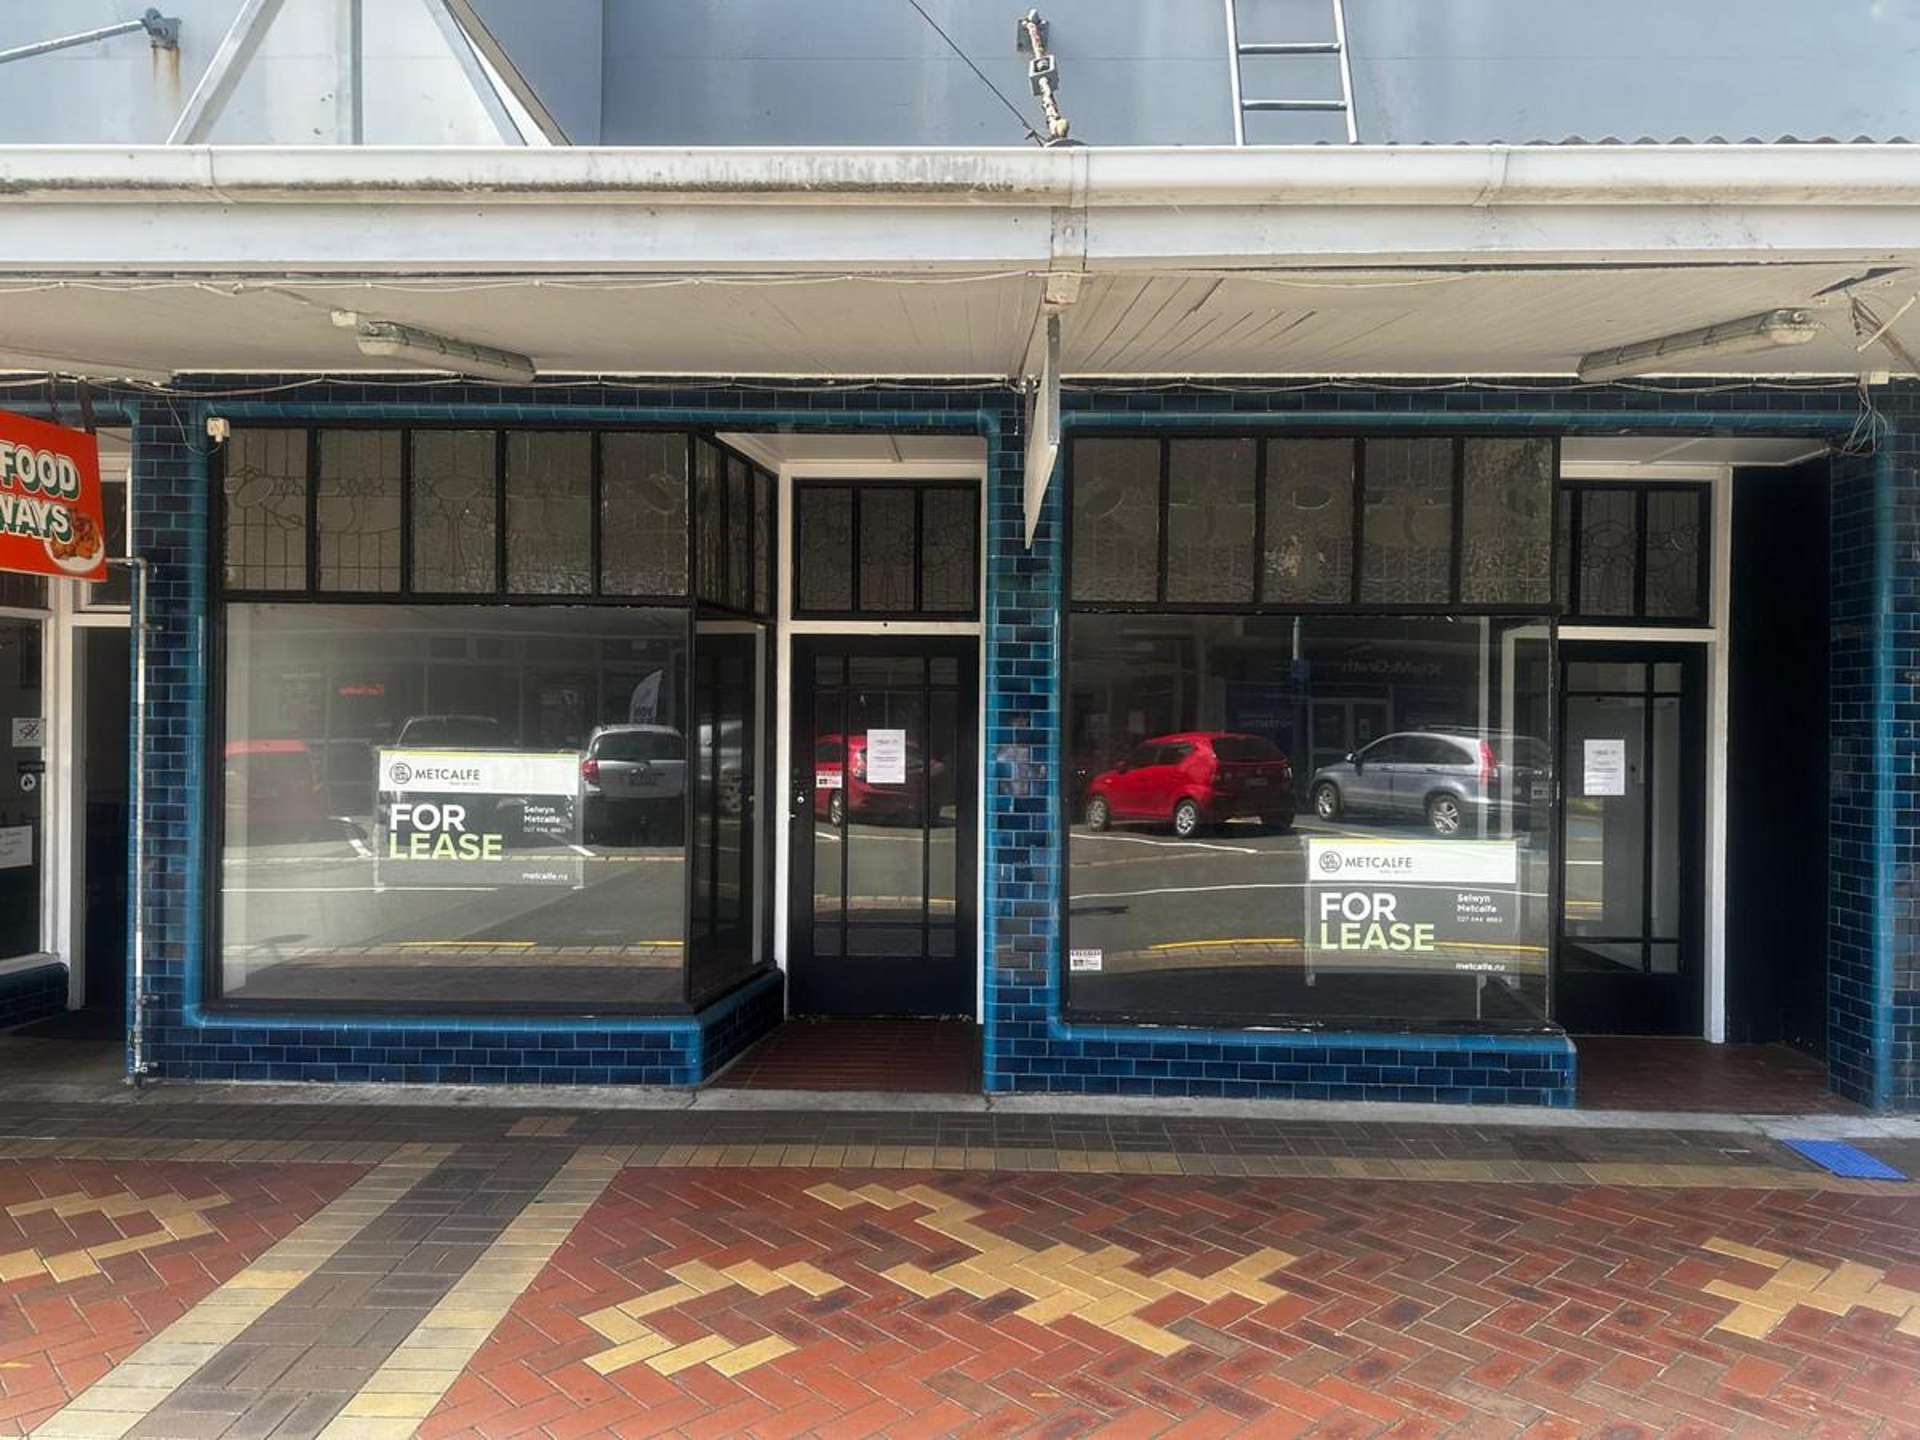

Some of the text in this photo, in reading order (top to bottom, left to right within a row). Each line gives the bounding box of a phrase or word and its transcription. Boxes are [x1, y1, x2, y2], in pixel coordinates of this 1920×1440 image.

[0, 441, 79, 498] FOOD
[415, 768, 480, 780] METCALFE
[524, 806, 555, 815] Selwyn
[390, 803, 465, 832] FOR
[524, 815, 561, 824] Metcalfe
[390, 832, 502, 861] LEASE
[1345, 857, 1413, 869] METCALFE
[1457, 893, 1491, 904] Selwyn
[1320, 891, 1397, 921] FOR
[1457, 904, 1497, 913] Metcalfe
[1320, 921, 1434, 951] LEASE
